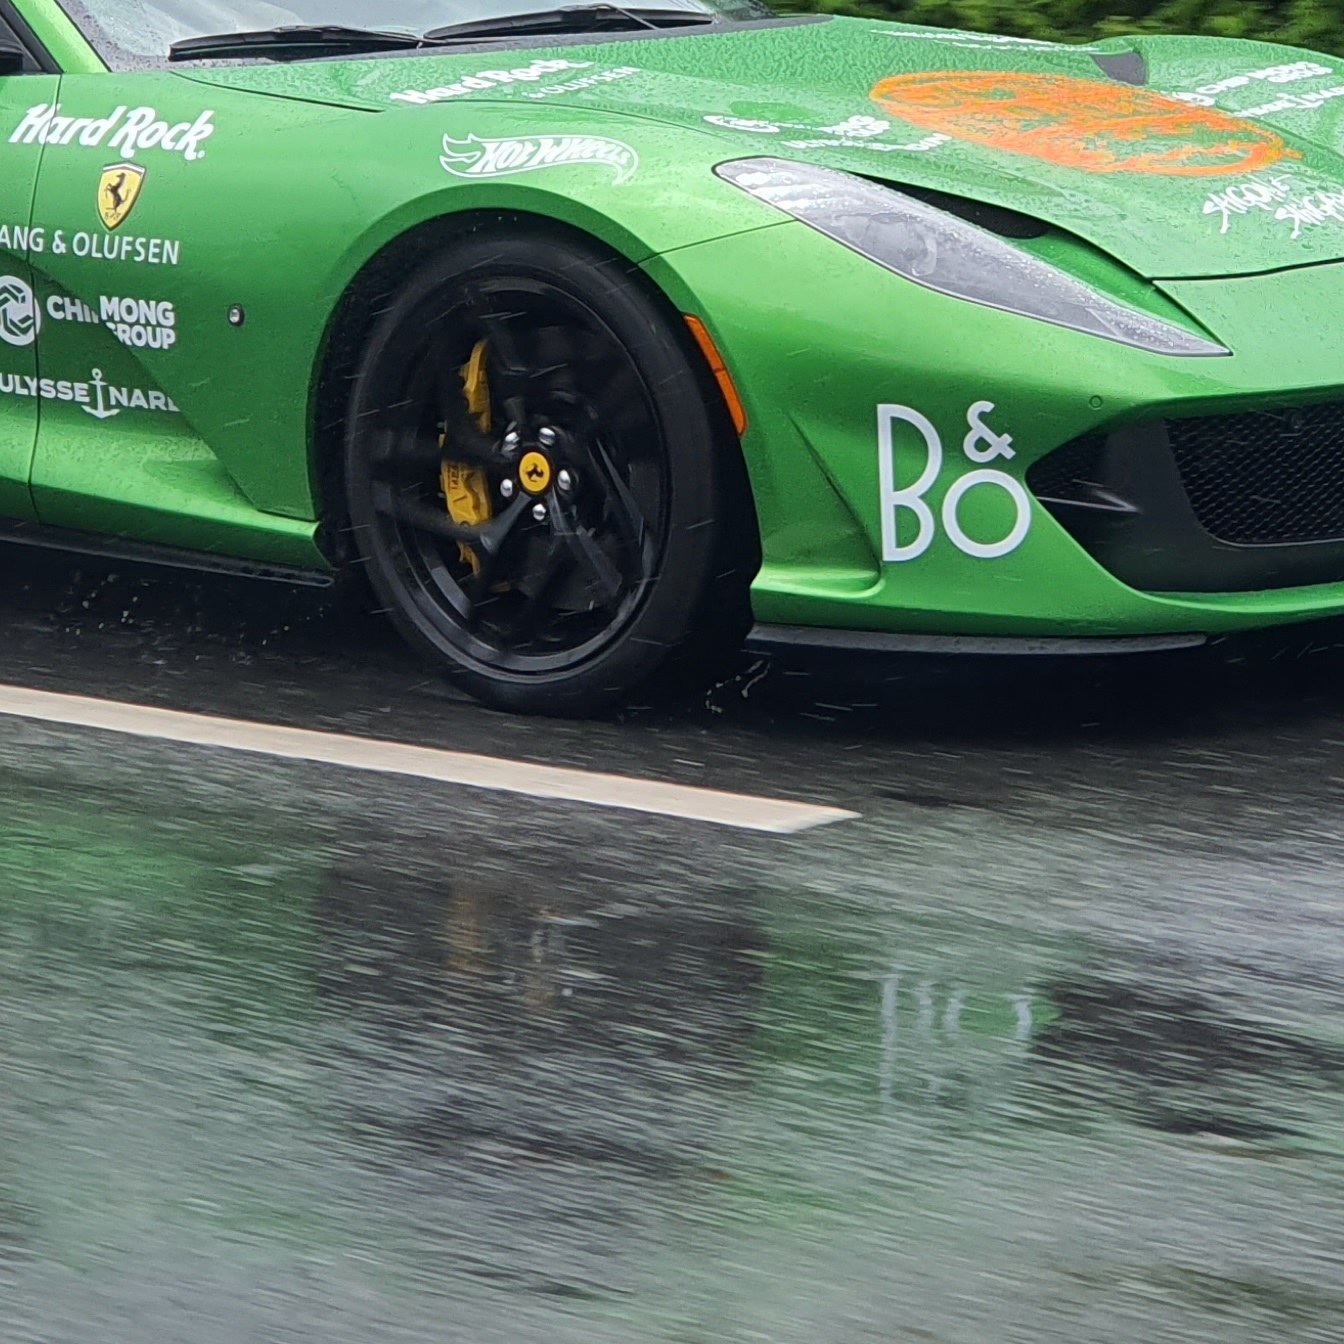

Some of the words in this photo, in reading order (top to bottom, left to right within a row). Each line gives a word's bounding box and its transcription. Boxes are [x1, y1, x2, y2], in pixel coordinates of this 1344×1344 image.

[8, 103, 128, 146] Hard
[108, 106, 215, 160] Rock
[51, 229, 67, 255] &
[72, 231, 180, 266] OLUFSEN
[46, 295, 100, 325] CHI
[99, 295, 176, 327] MONG
